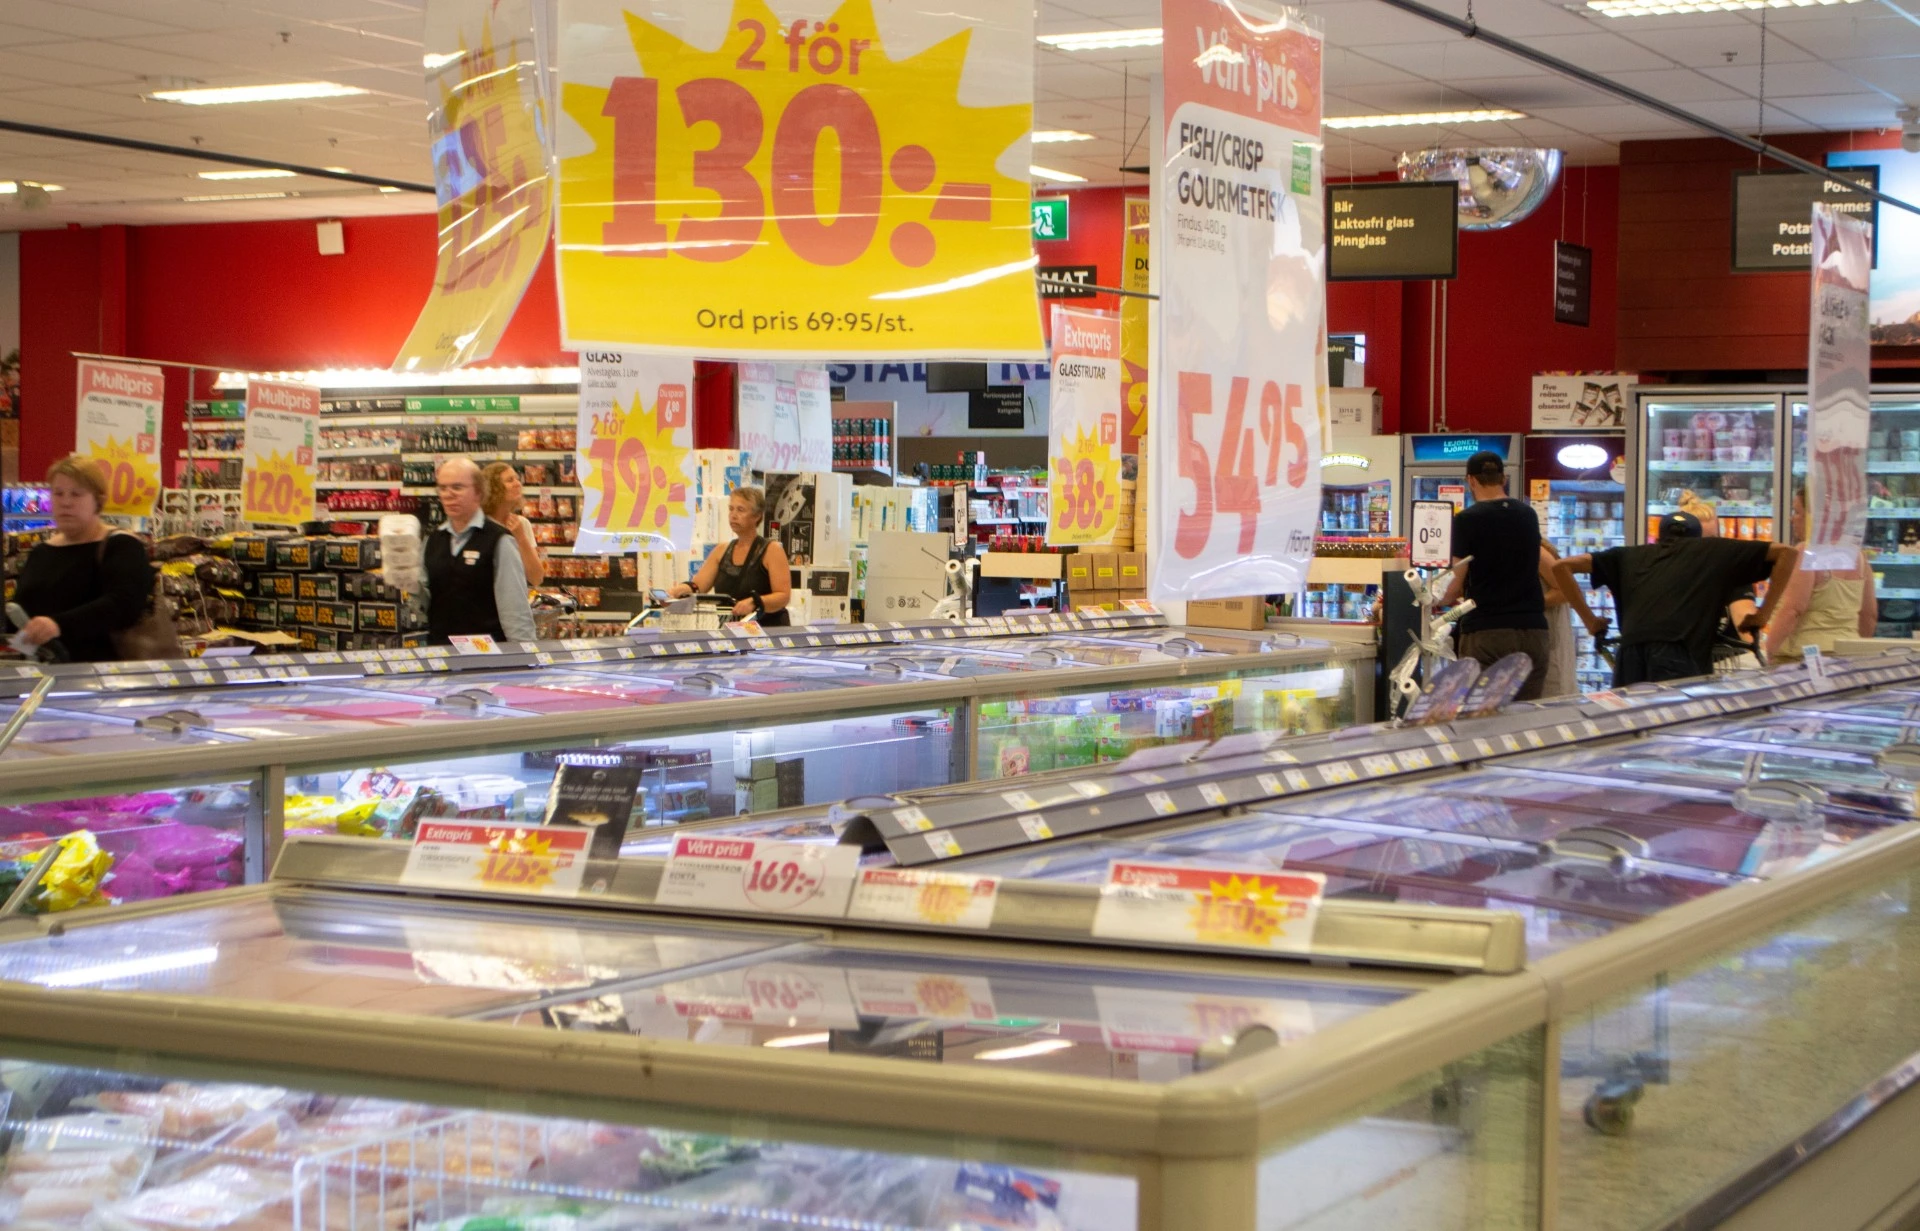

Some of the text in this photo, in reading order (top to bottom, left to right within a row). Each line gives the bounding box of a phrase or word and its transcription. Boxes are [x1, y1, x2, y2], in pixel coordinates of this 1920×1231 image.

[735, 18, 870, 76] 2 för
[1195, 26, 1298, 113] Vårt pris
[1180, 122, 1264, 173] FISH/CRISP
[601, 76, 992, 269] 130:-
[1177, 170, 1287, 225] GOURMETFISK
[1333, 201, 1354, 213] Bär
[1333, 215, 1415, 231] Laktosfri glass
[1333, 233, 1387, 249] Pinnglass
[696, 309, 915, 335] Ord pris 69:95/st.
[1064, 324, 1112, 355] Extrapris
[91, 369, 154, 397] Multipris
[1059, 362, 1107, 381] GLASSTRUTAR
[257, 386, 312, 413] Multipris
[1542, 383, 1557, 391] Five
[1537, 402, 1571, 410] obsessed
[590, 411, 625, 436] 2 för
[246, 470, 311, 515] 120:-
[588, 437, 686, 528] 79:-
[1057, 457, 1115, 530] 38:-
[425, 827, 473, 842] Extrapris
[687, 839, 745, 858] Vårt pris!
[747, 860, 816, 895] 169:-
